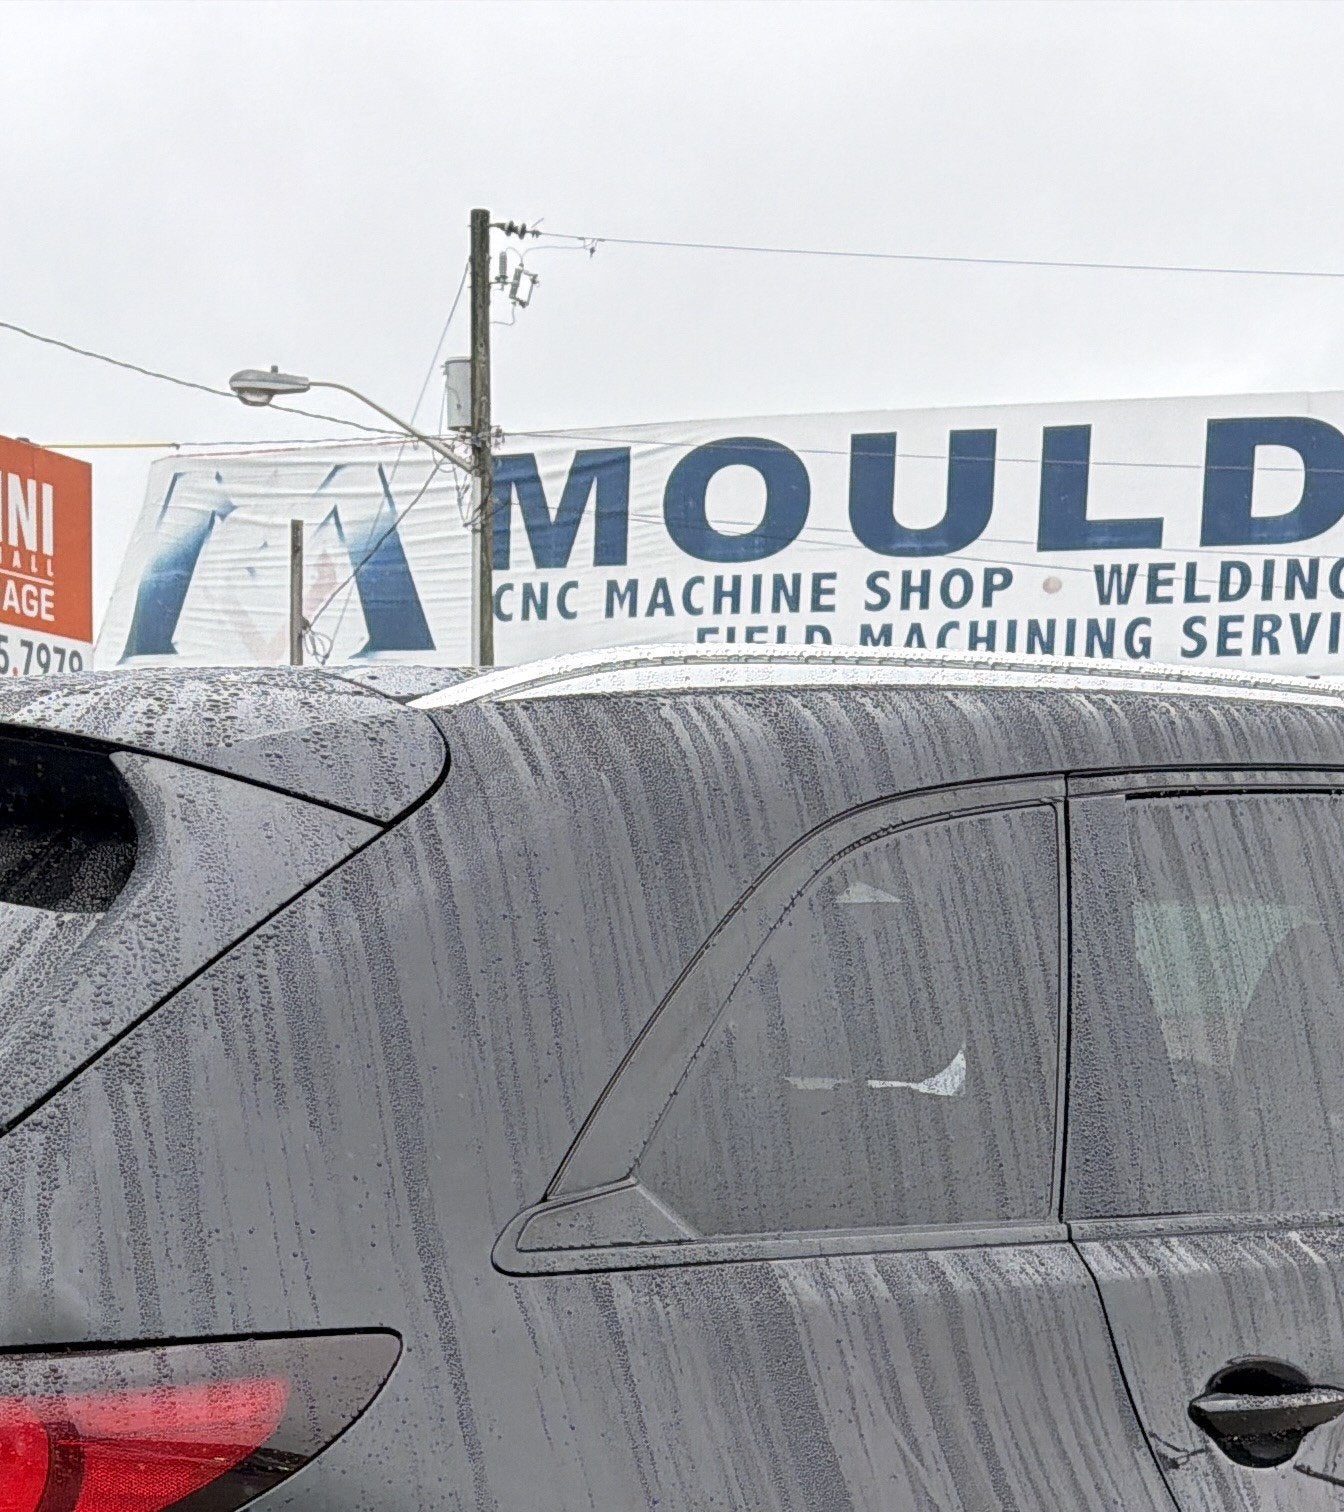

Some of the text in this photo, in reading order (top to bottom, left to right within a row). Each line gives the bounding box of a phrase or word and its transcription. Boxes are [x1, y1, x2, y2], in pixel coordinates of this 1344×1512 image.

[493, 580, 580, 622] CNC
[604, 571, 838, 619] MACHINE
[863, 566, 1014, 612] SHOP
[859, 616, 1153, 660] MACHINING
